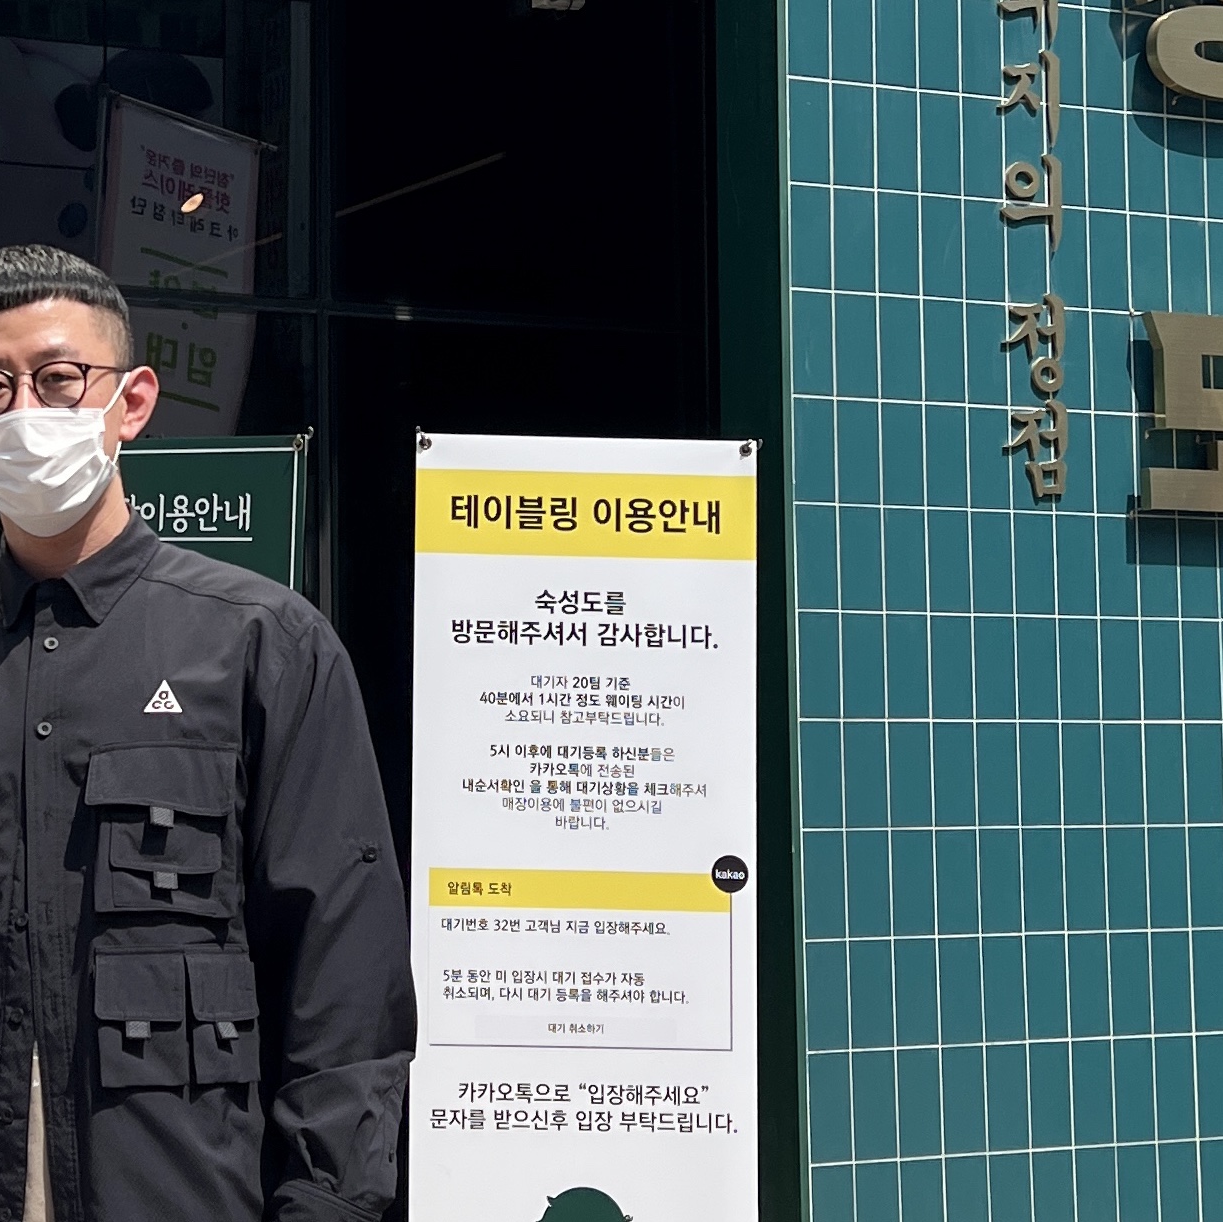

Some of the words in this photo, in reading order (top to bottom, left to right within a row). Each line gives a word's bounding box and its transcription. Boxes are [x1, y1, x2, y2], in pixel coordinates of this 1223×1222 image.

[1001, 294, 1066, 501] 정점
[125, 493, 251, 533] 이용안내
[450, 494, 579, 532] 테이블링
[593, 497, 721, 535] 이용안내
[534, 589, 627, 615] 숙성도를
[450, 619, 587, 647] 방문해주셔서
[597, 622, 719, 650] 감사합니다.
[530, 675, 569, 690] 대기자
[572, 676, 601, 690] 20팀
[605, 676, 631, 691] 기준
[479, 691, 534, 707] 40분에서
[539, 693, 572, 708] 1시간
[575, 693, 601, 708] 정도
[605, 694, 643, 710] 웨이팅
[647, 695, 685, 710] 시간이
[505, 710, 555, 724] 소요되니
[560, 710, 665, 727] 참고부탁드립니다.
[490, 744, 510, 758] 5시
[514, 744, 552, 759] 이후에
[557, 745, 607, 761] 대기등록
[612, 746, 676, 762] 하신분들은
[529, 762, 593, 778] 카카오톡에
[597, 764, 636, 779] 전송된
[462, 778, 525, 794] 내순서확인
[530, 780, 542, 794] 을
[546, 780, 573, 796] 통해
[576, 780, 640, 796] 대기상황을
[643, 782, 708, 798] 체크해주셔
[502, 796, 565, 813] 매장이용에
[569, 798, 608, 814] 불편이
[611, 799, 663, 815] 없으시길
[555, 816, 610, 831] 바랍니다.
[715, 868, 746, 880] kakao
[447, 880, 484, 896] 알림톡
[487, 882, 513, 897] 도착
[441, 918, 490, 932] 대기번호
[493, 919, 521, 934] 32번
[525, 919, 561, 934] 고객님
[565, 920, 590, 935] 지금
[593, 921, 671, 936] 입장해주세요.
[442, 969, 463, 983] 5분
[466, 969, 491, 984] 동안
[495, 969, 507, 985] 미
[511, 969, 548, 985] 입장시
[552, 970, 577, 986] 대기
[580, 971, 617, 986] 접수가
[620, 971, 645, 986] 자동
[442, 986, 495, 1001] 취소되며,
[499, 987, 523, 1002] 다시
[527, 987, 552, 1002] 대기
[555, 988, 592, 1003] 등록을
[596, 989, 645, 1004] 해주셔야
[649, 989, 690, 1005] 합니다.
[547, 1023, 566, 1034] 대기
[569, 1023, 605, 1035] 취소하기
[457, 1082, 571, 1104] 카카오톡으로
[429, 1108, 486, 1130] 문자를
[493, 1109, 569, 1132] 받으신후
[575, 1110, 613, 1132] 입장
[619, 1111, 738, 1134] 부탁드립니다.
